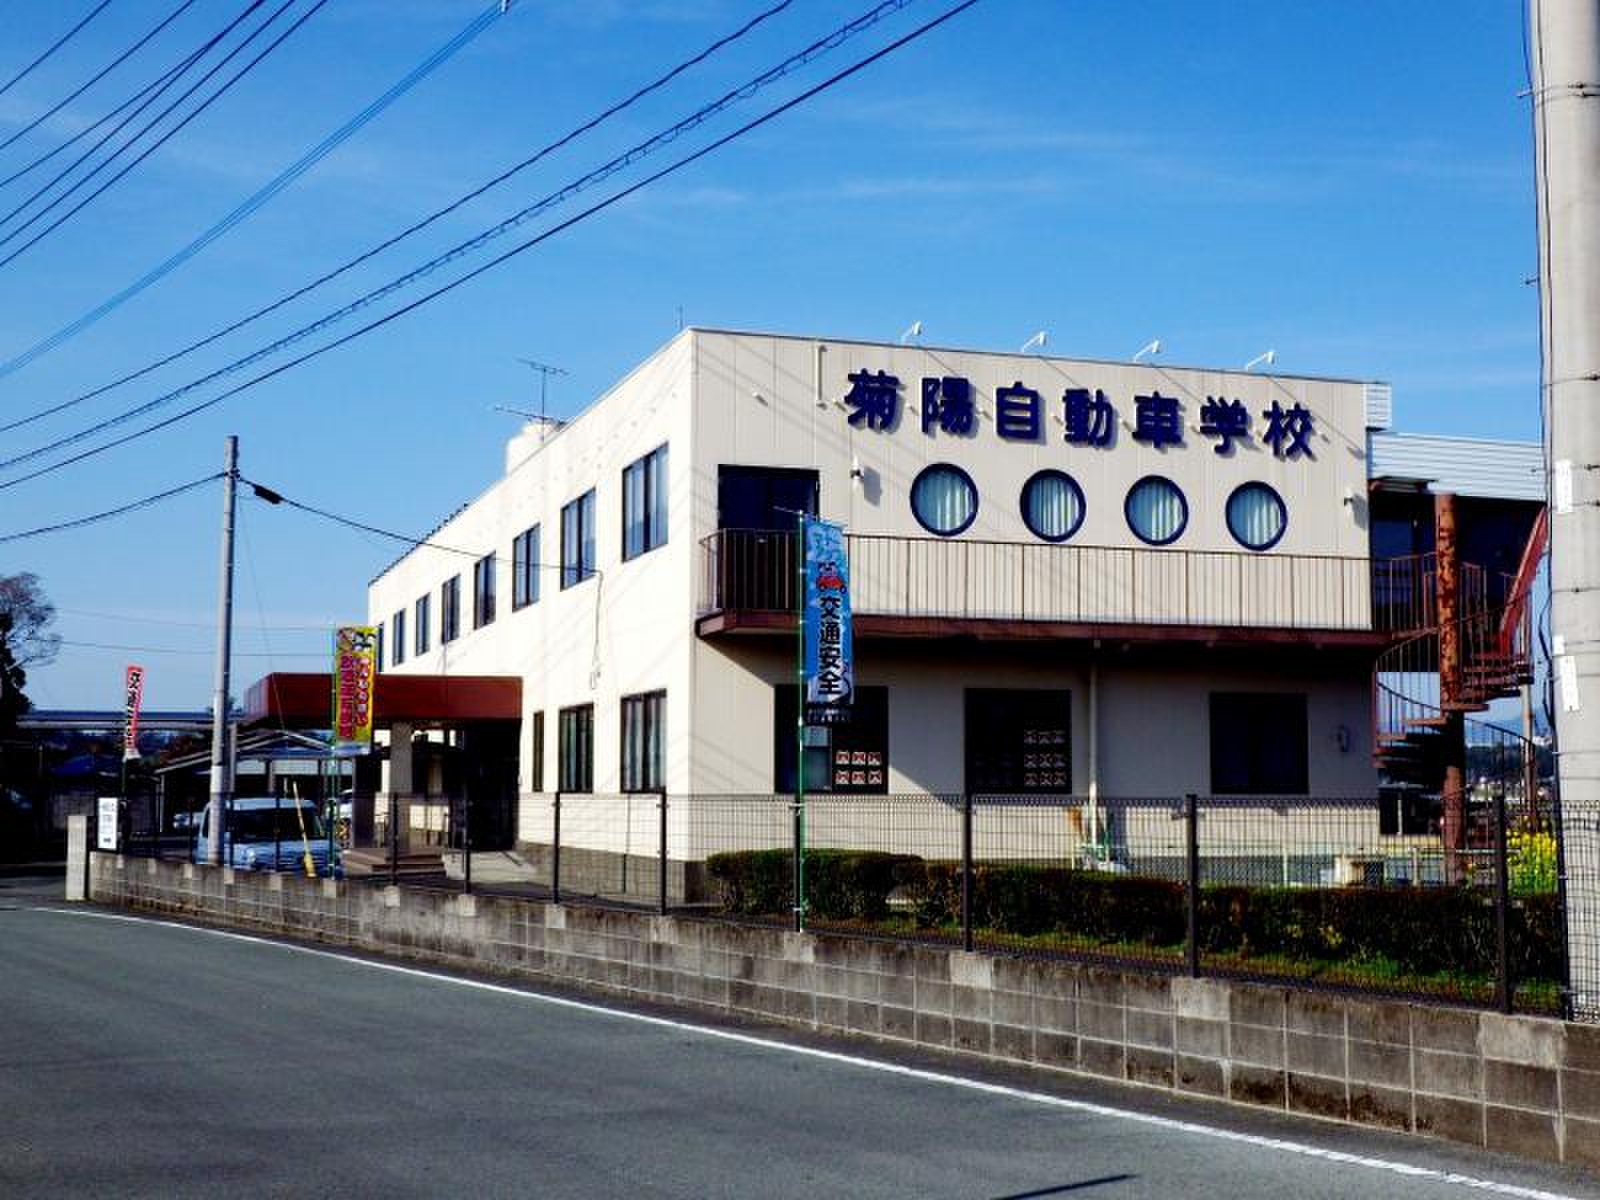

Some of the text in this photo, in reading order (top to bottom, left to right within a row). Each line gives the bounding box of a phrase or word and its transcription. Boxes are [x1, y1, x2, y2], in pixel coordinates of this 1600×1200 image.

[845, 368, 1317, 460] 菊陽自動車学校
[817, 596, 843, 696] 交通安全
